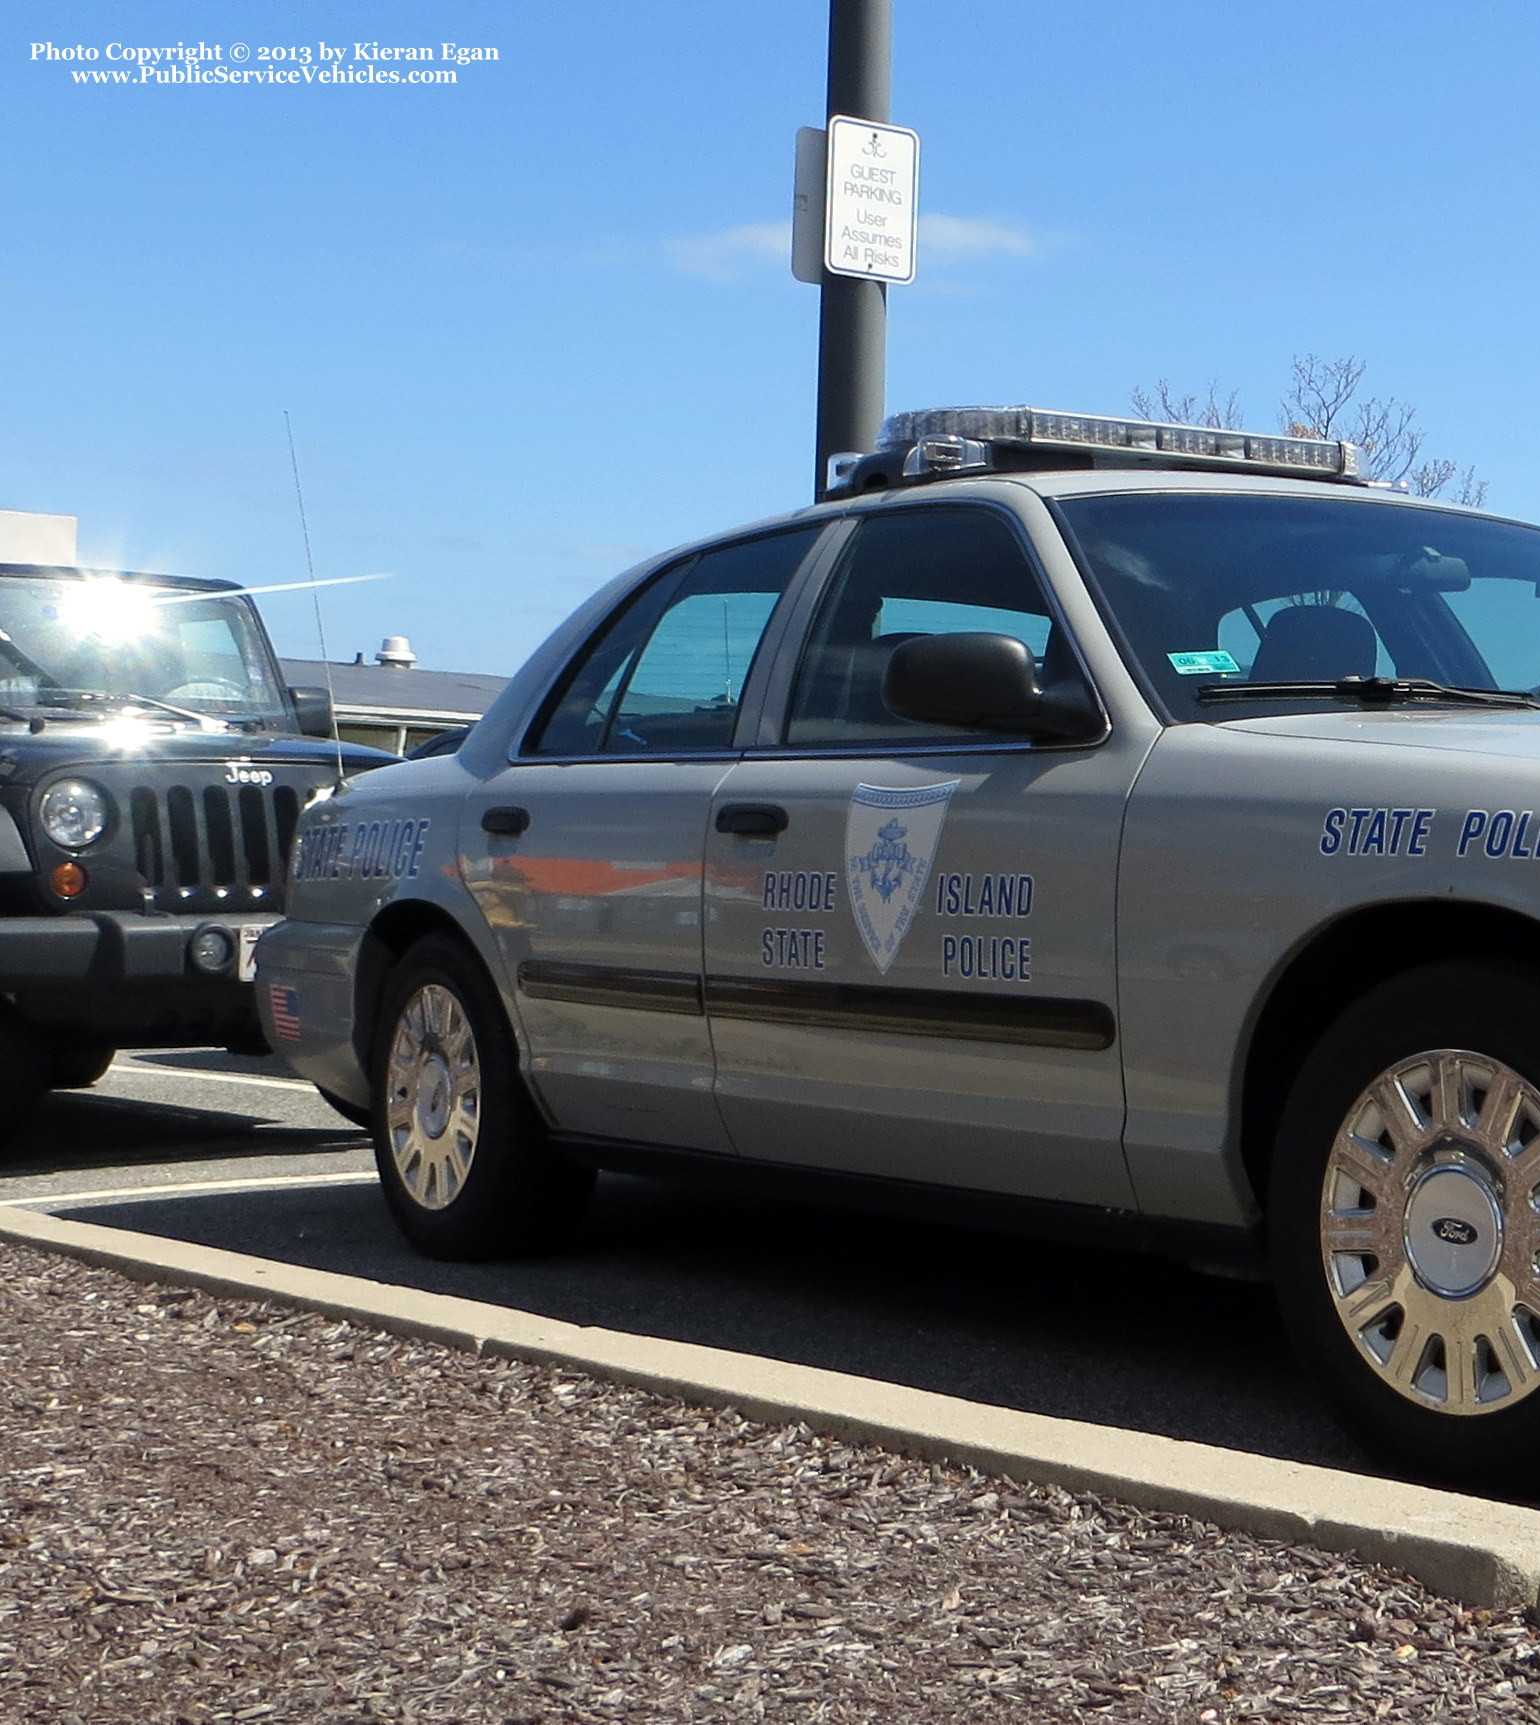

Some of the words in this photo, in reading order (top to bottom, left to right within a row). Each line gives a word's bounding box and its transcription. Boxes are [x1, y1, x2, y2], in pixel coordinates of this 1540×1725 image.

[850, 163, 896, 185] GUEST
[843, 181, 902, 205] PARKING
[856, 209, 888, 227] User
[841, 226, 902, 249] Assumes
[843, 245, 859, 260] All
[864, 247, 899, 267] Risks
[225, 767, 273, 786] Jeep
[1319, 808, 1436, 857] STATE
[295, 824, 348, 881] STATE
[349, 818, 431, 880] POLICE
[763, 871, 837, 912] RHODE
[936, 873, 1034, 918] ISLAND
[762, 928, 825, 969] STATE
[942, 935, 1032, 981] POLICE
[1440, 1220, 1469, 1241] Ford
